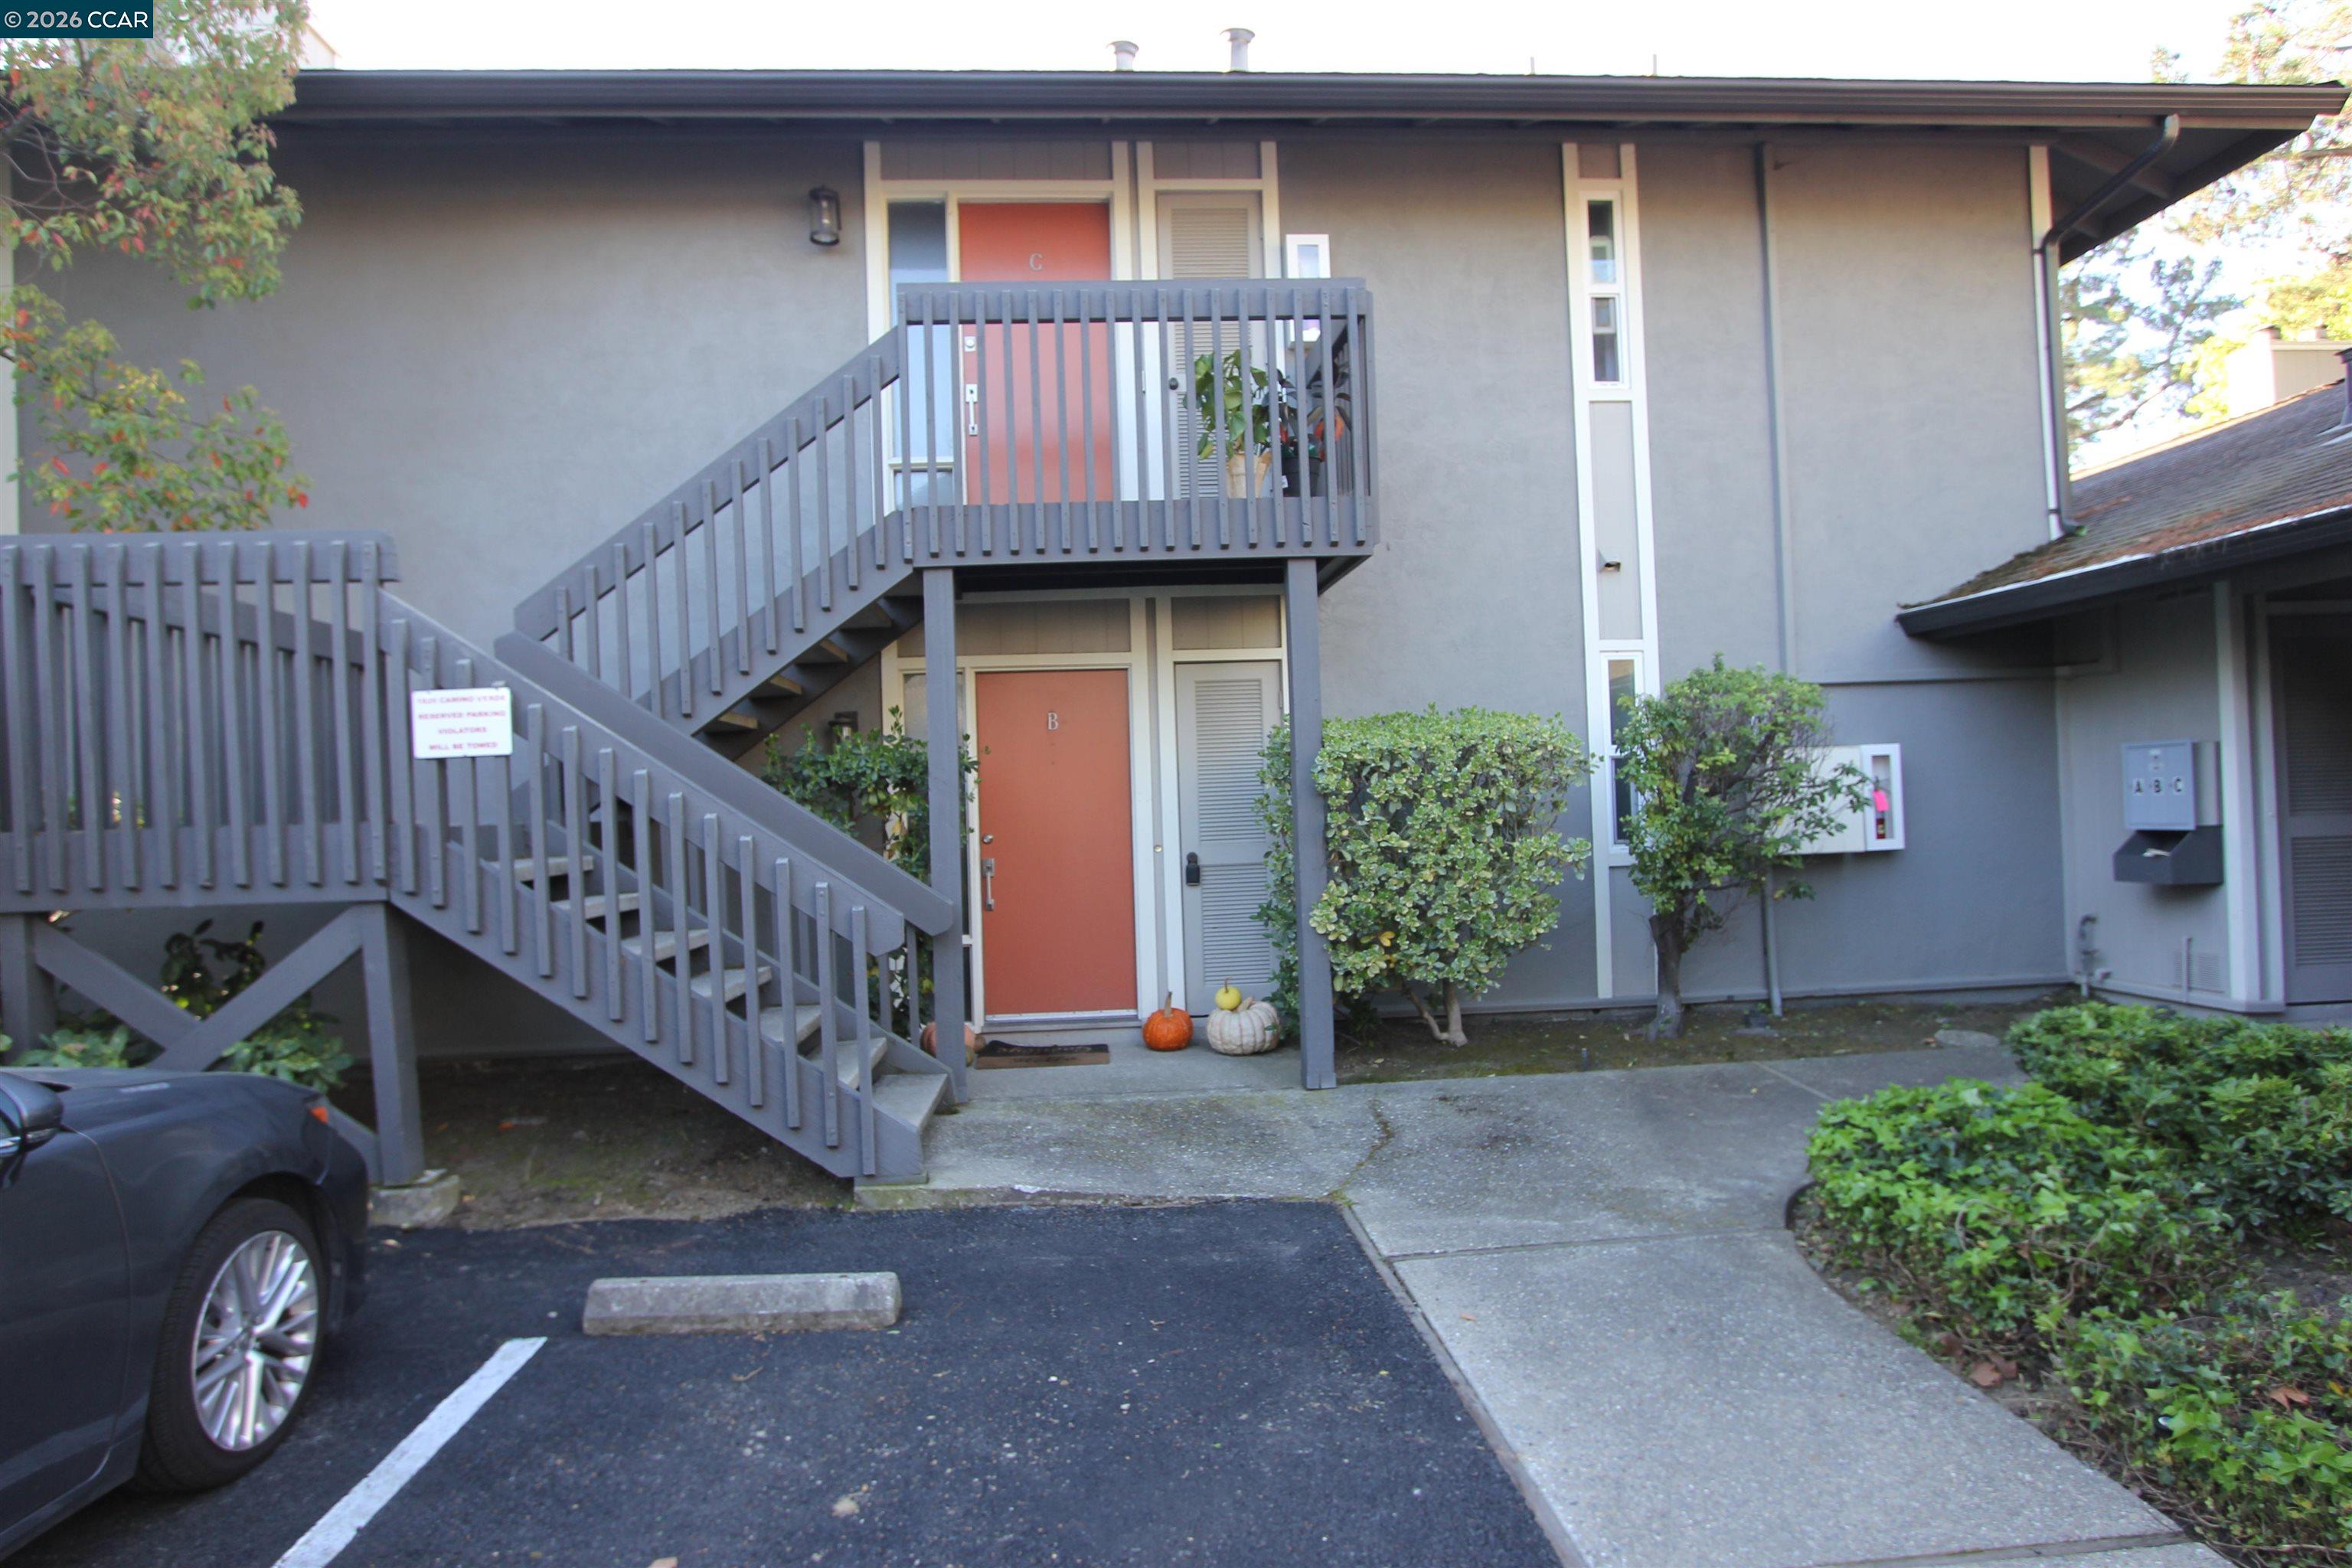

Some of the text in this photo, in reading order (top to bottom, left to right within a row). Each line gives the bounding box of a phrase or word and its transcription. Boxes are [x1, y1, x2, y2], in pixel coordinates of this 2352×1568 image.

[1047, 712, 1059, 730] B
[2134, 777, 2183, 793] A B C
